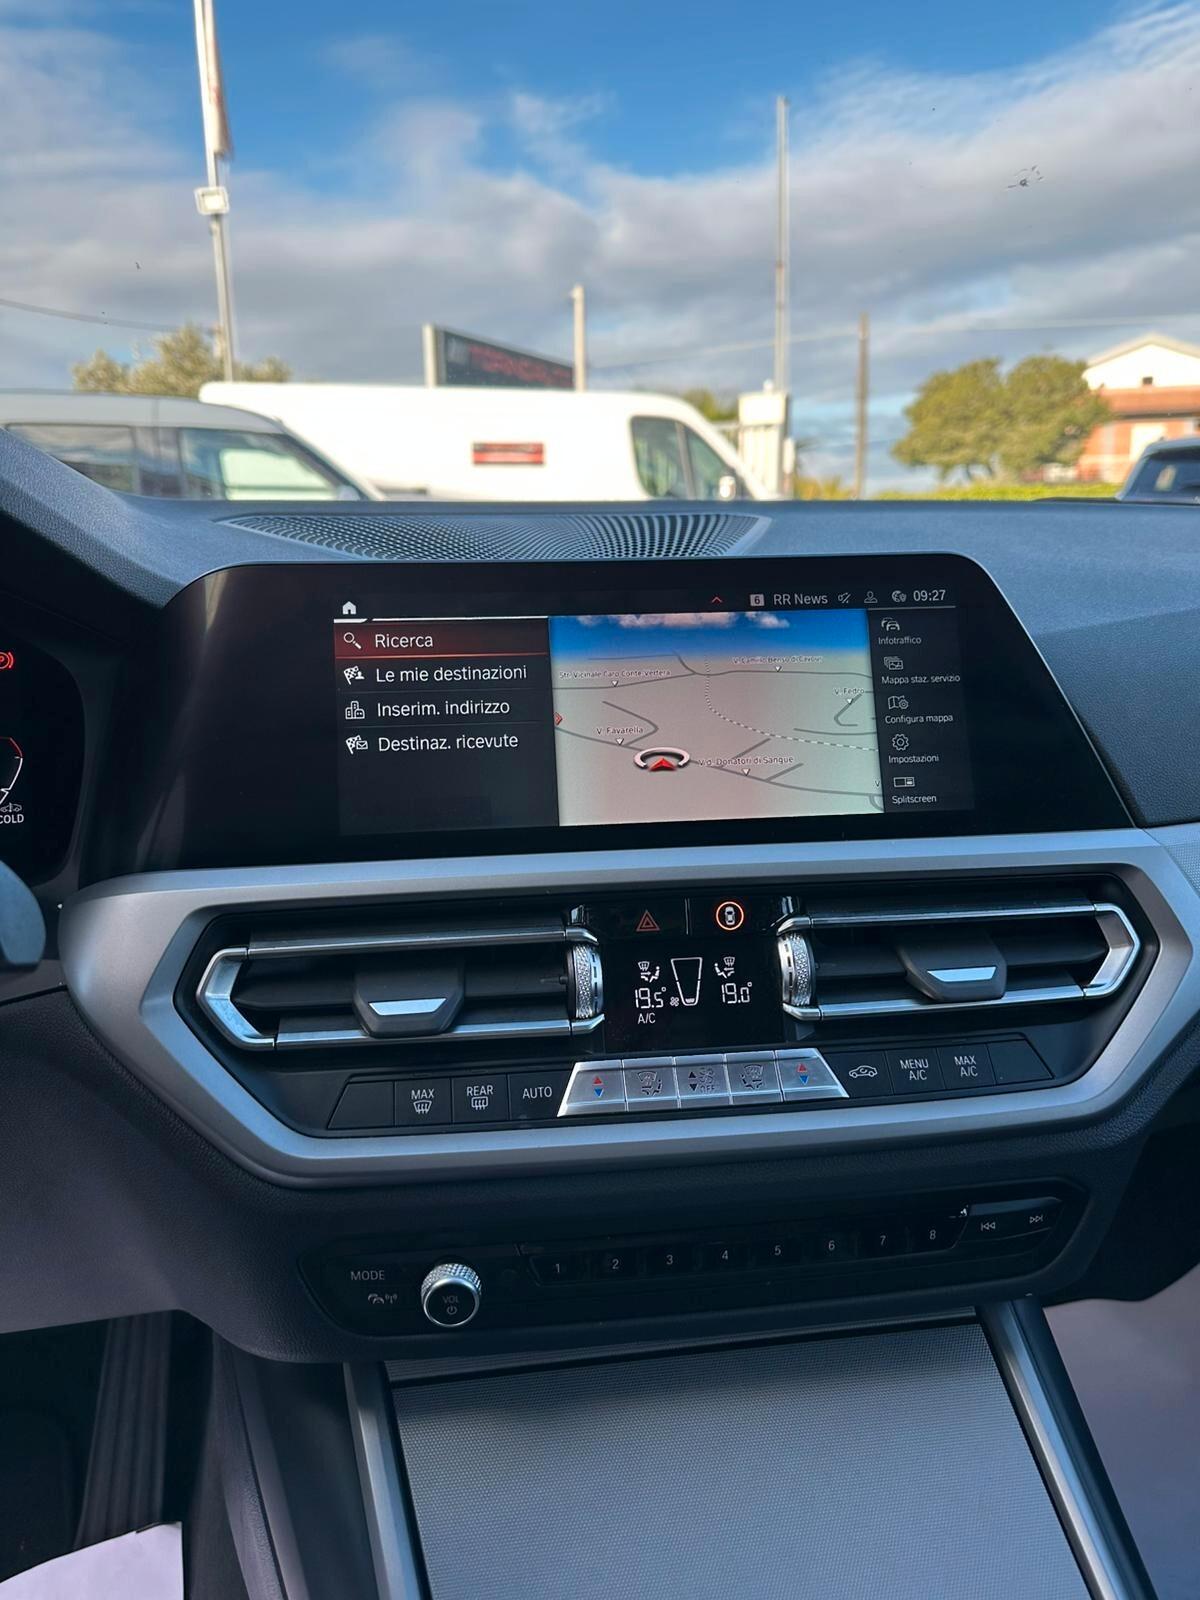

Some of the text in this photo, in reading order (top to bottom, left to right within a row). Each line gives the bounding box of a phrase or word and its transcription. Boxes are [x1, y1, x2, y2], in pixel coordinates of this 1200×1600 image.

[773, 593, 792, 605] RR
[794, 592, 828, 605] News
[913, 589, 946, 602] 09:27
[374, 633, 434, 649] Ricerca
[878, 636, 922, 645] Infotraffico
[376, 665, 527, 682] Le mie destinazioni
[881, 674, 961, 685] Mappa staz. servizio
[377, 700, 510, 716] Inserim. indirizzo
[885, 714, 954, 725] Configura mappa
[378, 733, 518, 751] Destinaz. ricevute
[762, 756, 794, 767] Sangue
[888, 755, 940, 764] Impostazioni
[891, 795, 937, 805] Splitscreen
[637, 1012, 656, 1025] A/C
[900, 1058, 929, 1070] MENU
[954, 1055, 977, 1066] MAX
[909, 1070, 928, 1081] A/C
[960, 1066, 978, 1077] A/C
[411, 1088, 435, 1100] MAX
[466, 1085, 494, 1097] REAR
[522, 1086, 553, 1099] AUTO
[929, 1229, 937, 1240] 8
[828, 1240, 836, 1251] 6
[880, 1235, 887, 1246] 7
[721, 1250, 729, 1260] 4
[774, 1245, 782, 1256] 5
[612, 1258, 619, 1270] 2
[666, 1254, 674, 1265] 3
[555, 1263, 561, 1273] 1
[350, 1270, 385, 1281] MODE
